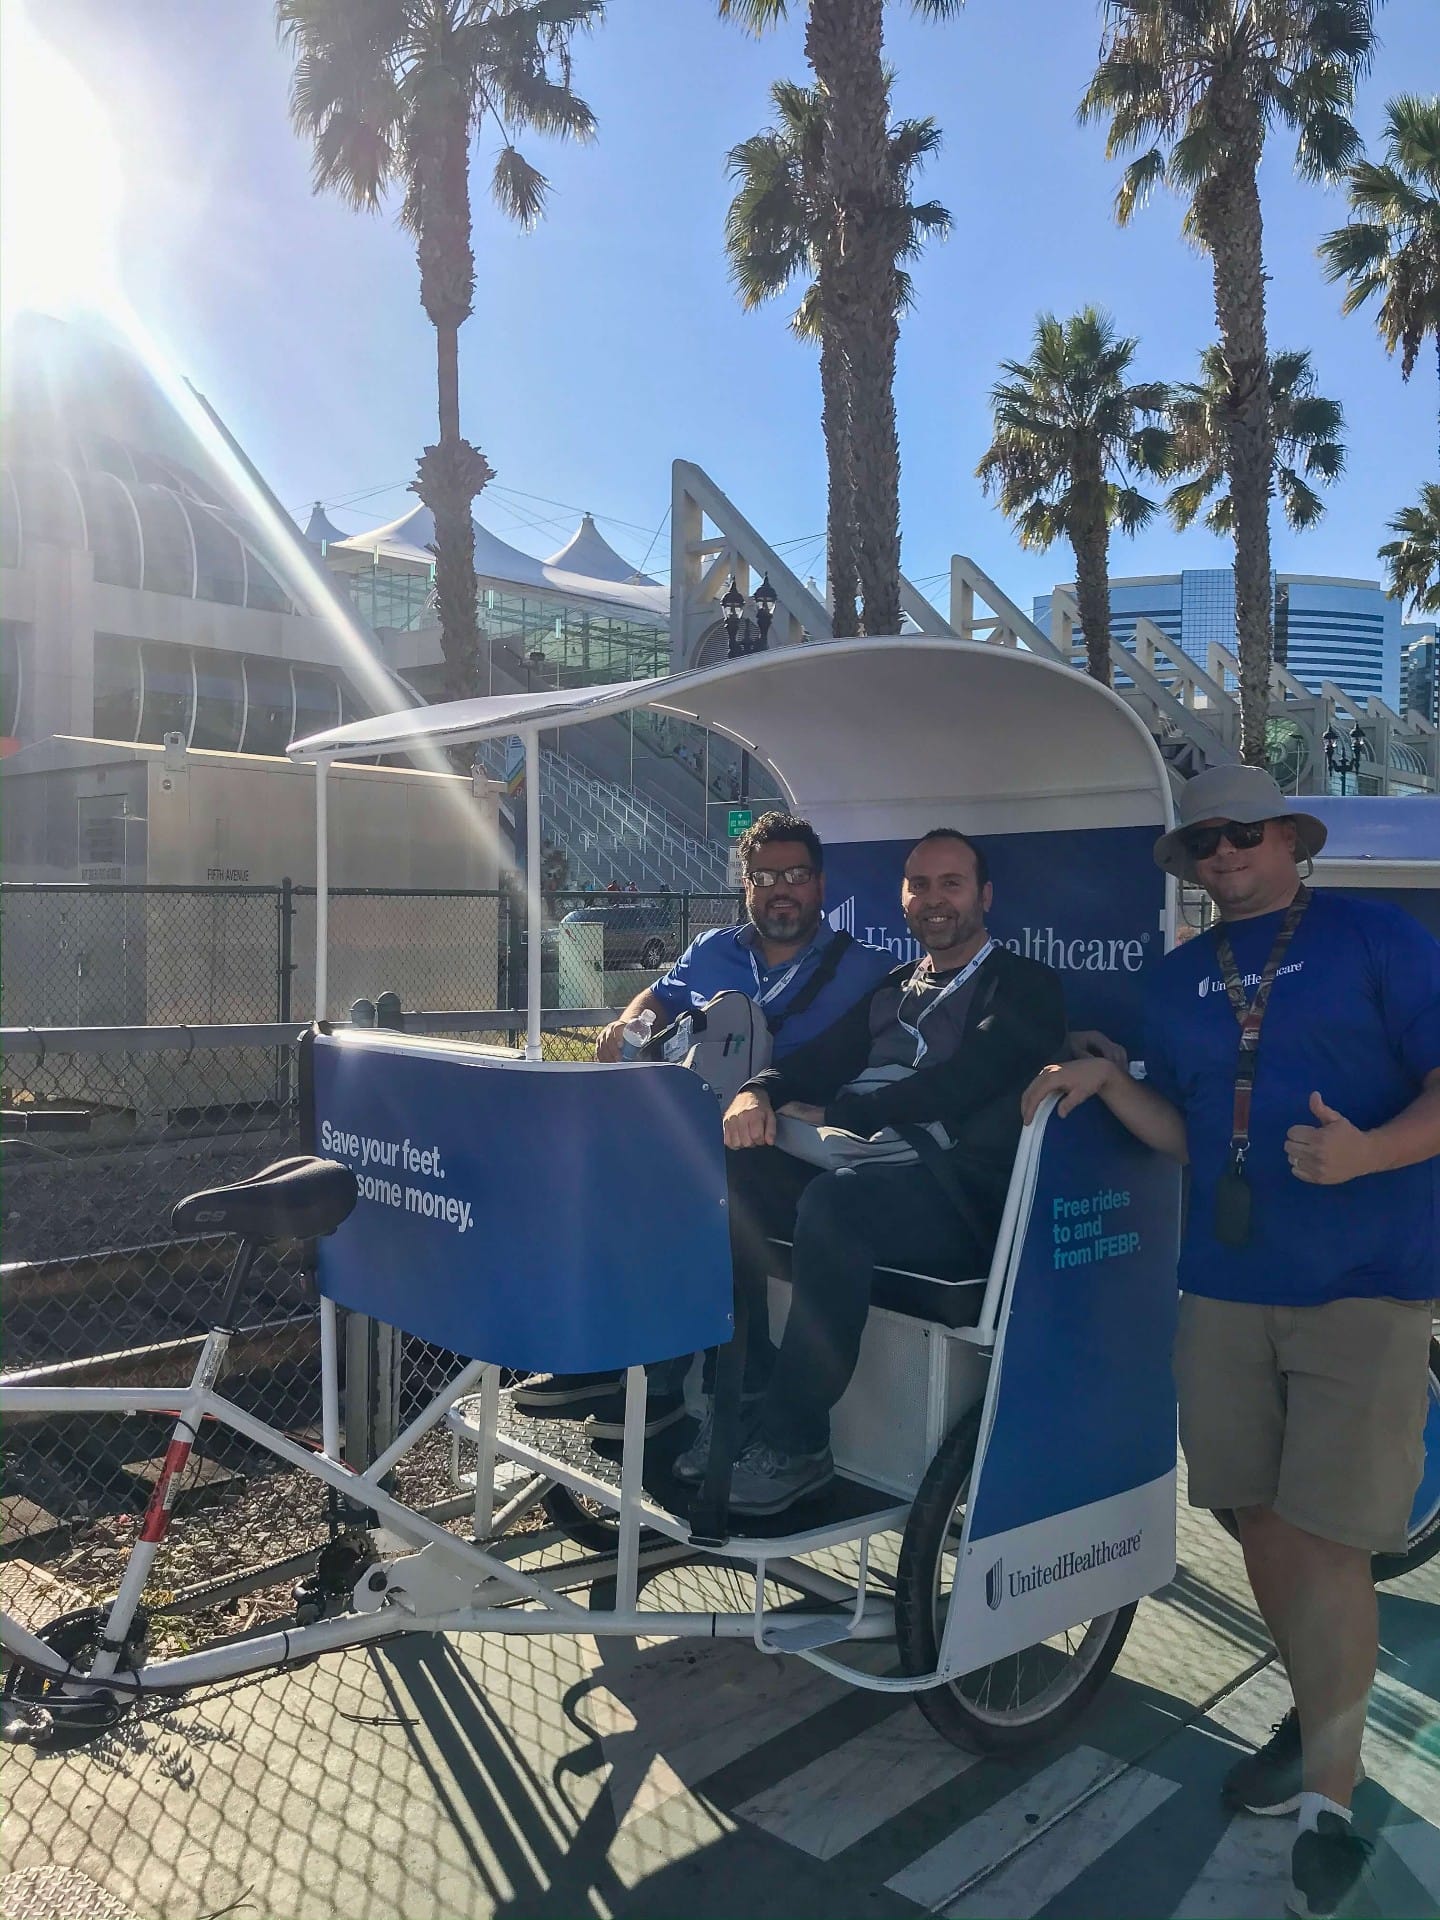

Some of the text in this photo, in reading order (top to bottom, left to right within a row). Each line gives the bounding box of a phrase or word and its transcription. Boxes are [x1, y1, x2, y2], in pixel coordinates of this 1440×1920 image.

[207, 868, 249, 882] FIFTH AVENUE
[322, 1120, 446, 1179] Save your feet.
[356, 1174, 474, 1233] some money.
[1053, 1188, 1131, 1220] Free rides
[1053, 1214, 1102, 1244] to and
[1053, 1231, 1142, 1270] from IFEBP.
[1008, 1533, 1141, 1598] UnitedHealthcare
